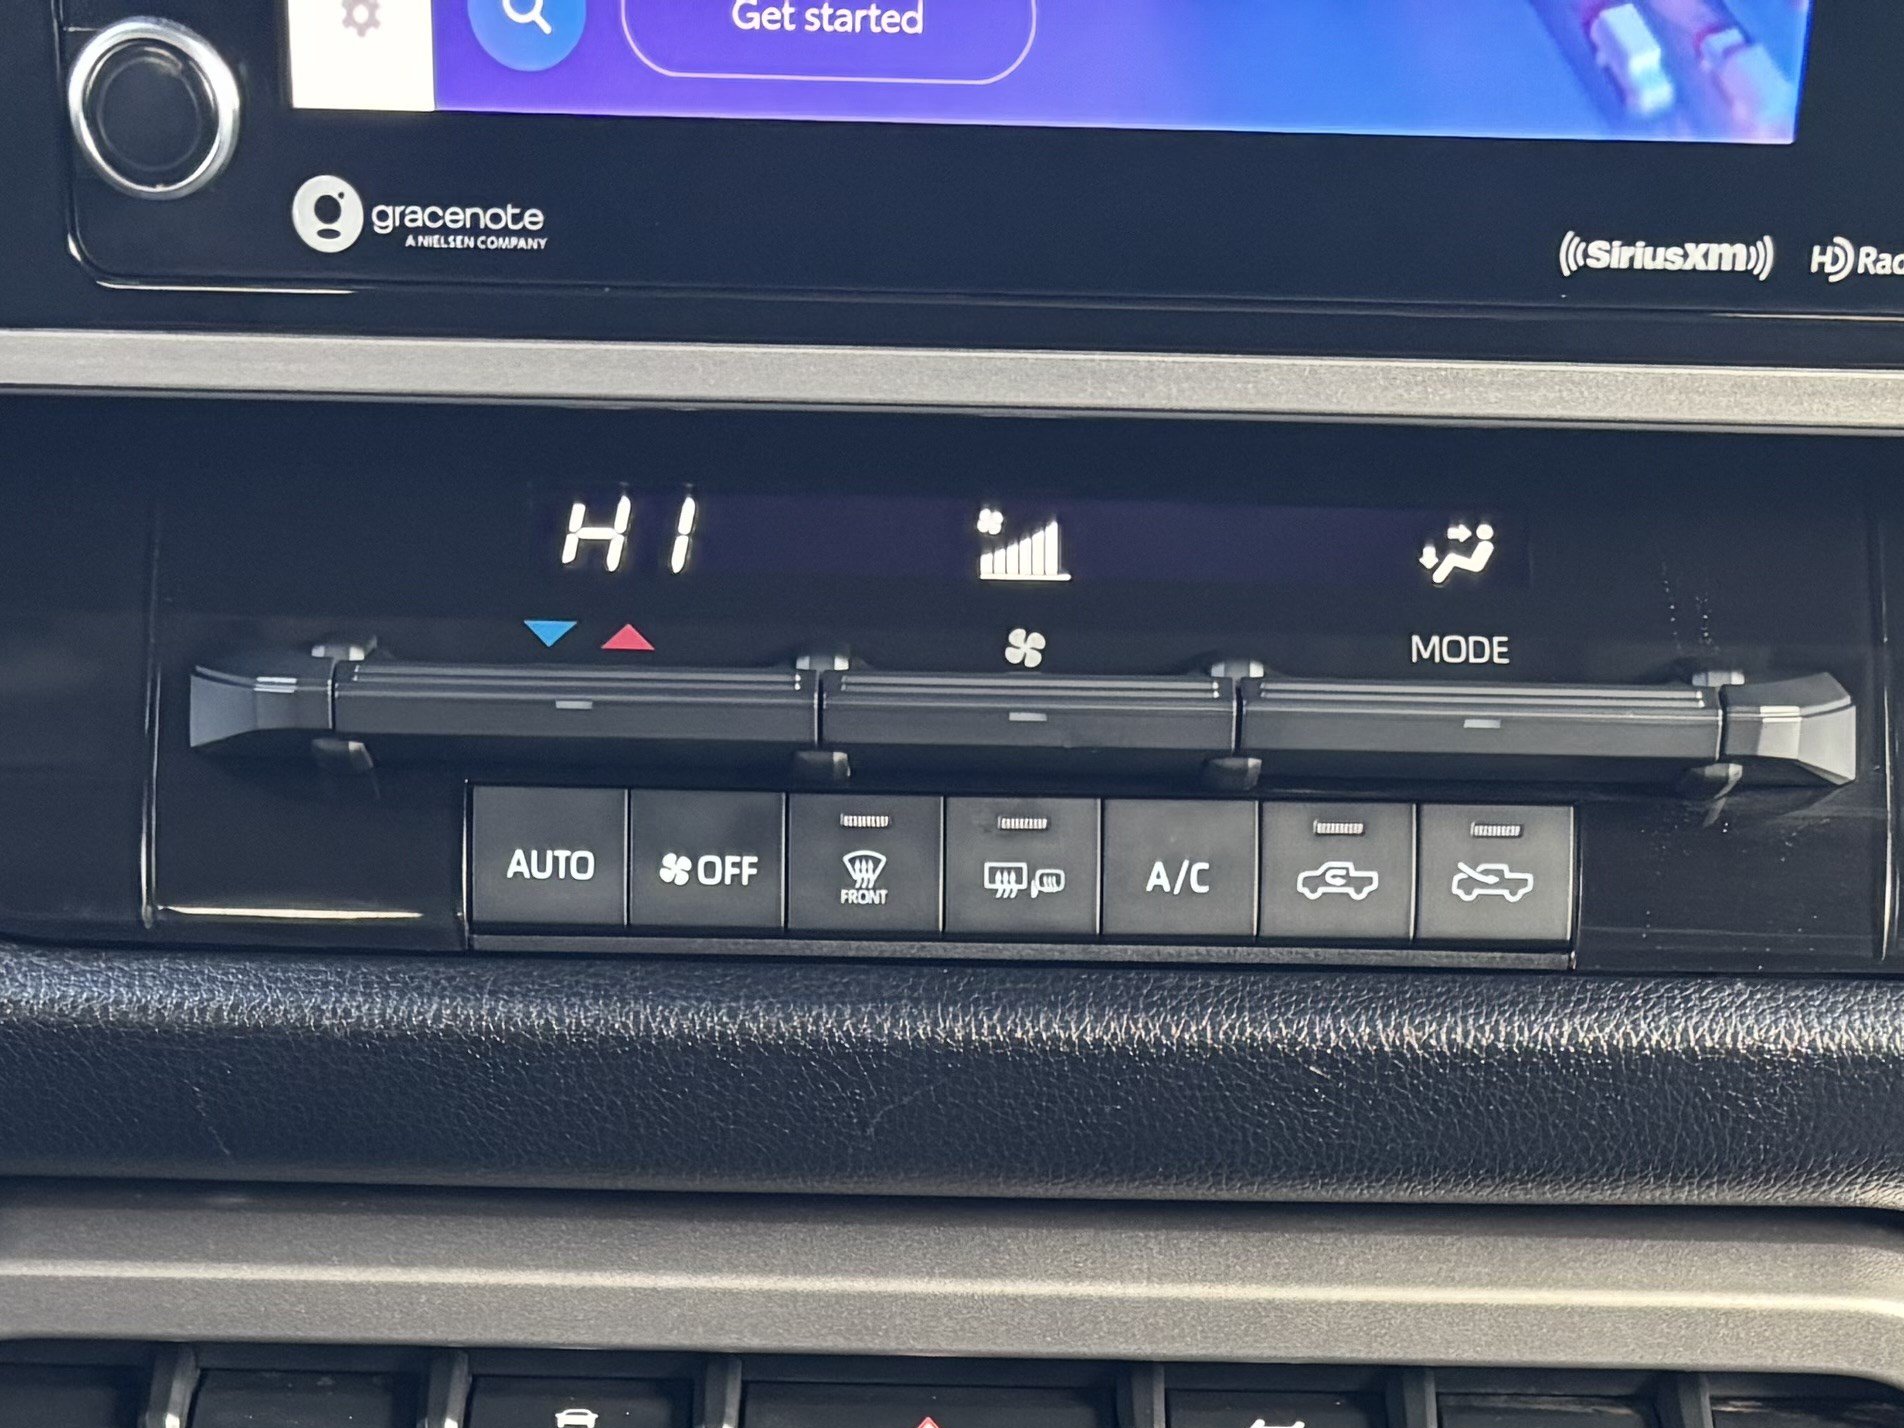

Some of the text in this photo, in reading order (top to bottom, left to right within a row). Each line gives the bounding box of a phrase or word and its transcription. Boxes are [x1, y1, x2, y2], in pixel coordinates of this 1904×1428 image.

[732, 0, 923, 33] Get started
[372, 204, 544, 233] gracenote
[406, 235, 547, 249] A NIELSEN COMPANY
[1412, 635, 1509, 663] MODE
[507, 849, 594, 880] AUTO
[698, 855, 758, 885] OFF
[1146, 860, 1209, 894] A/C
[840, 888, 888, 906] FRONT
